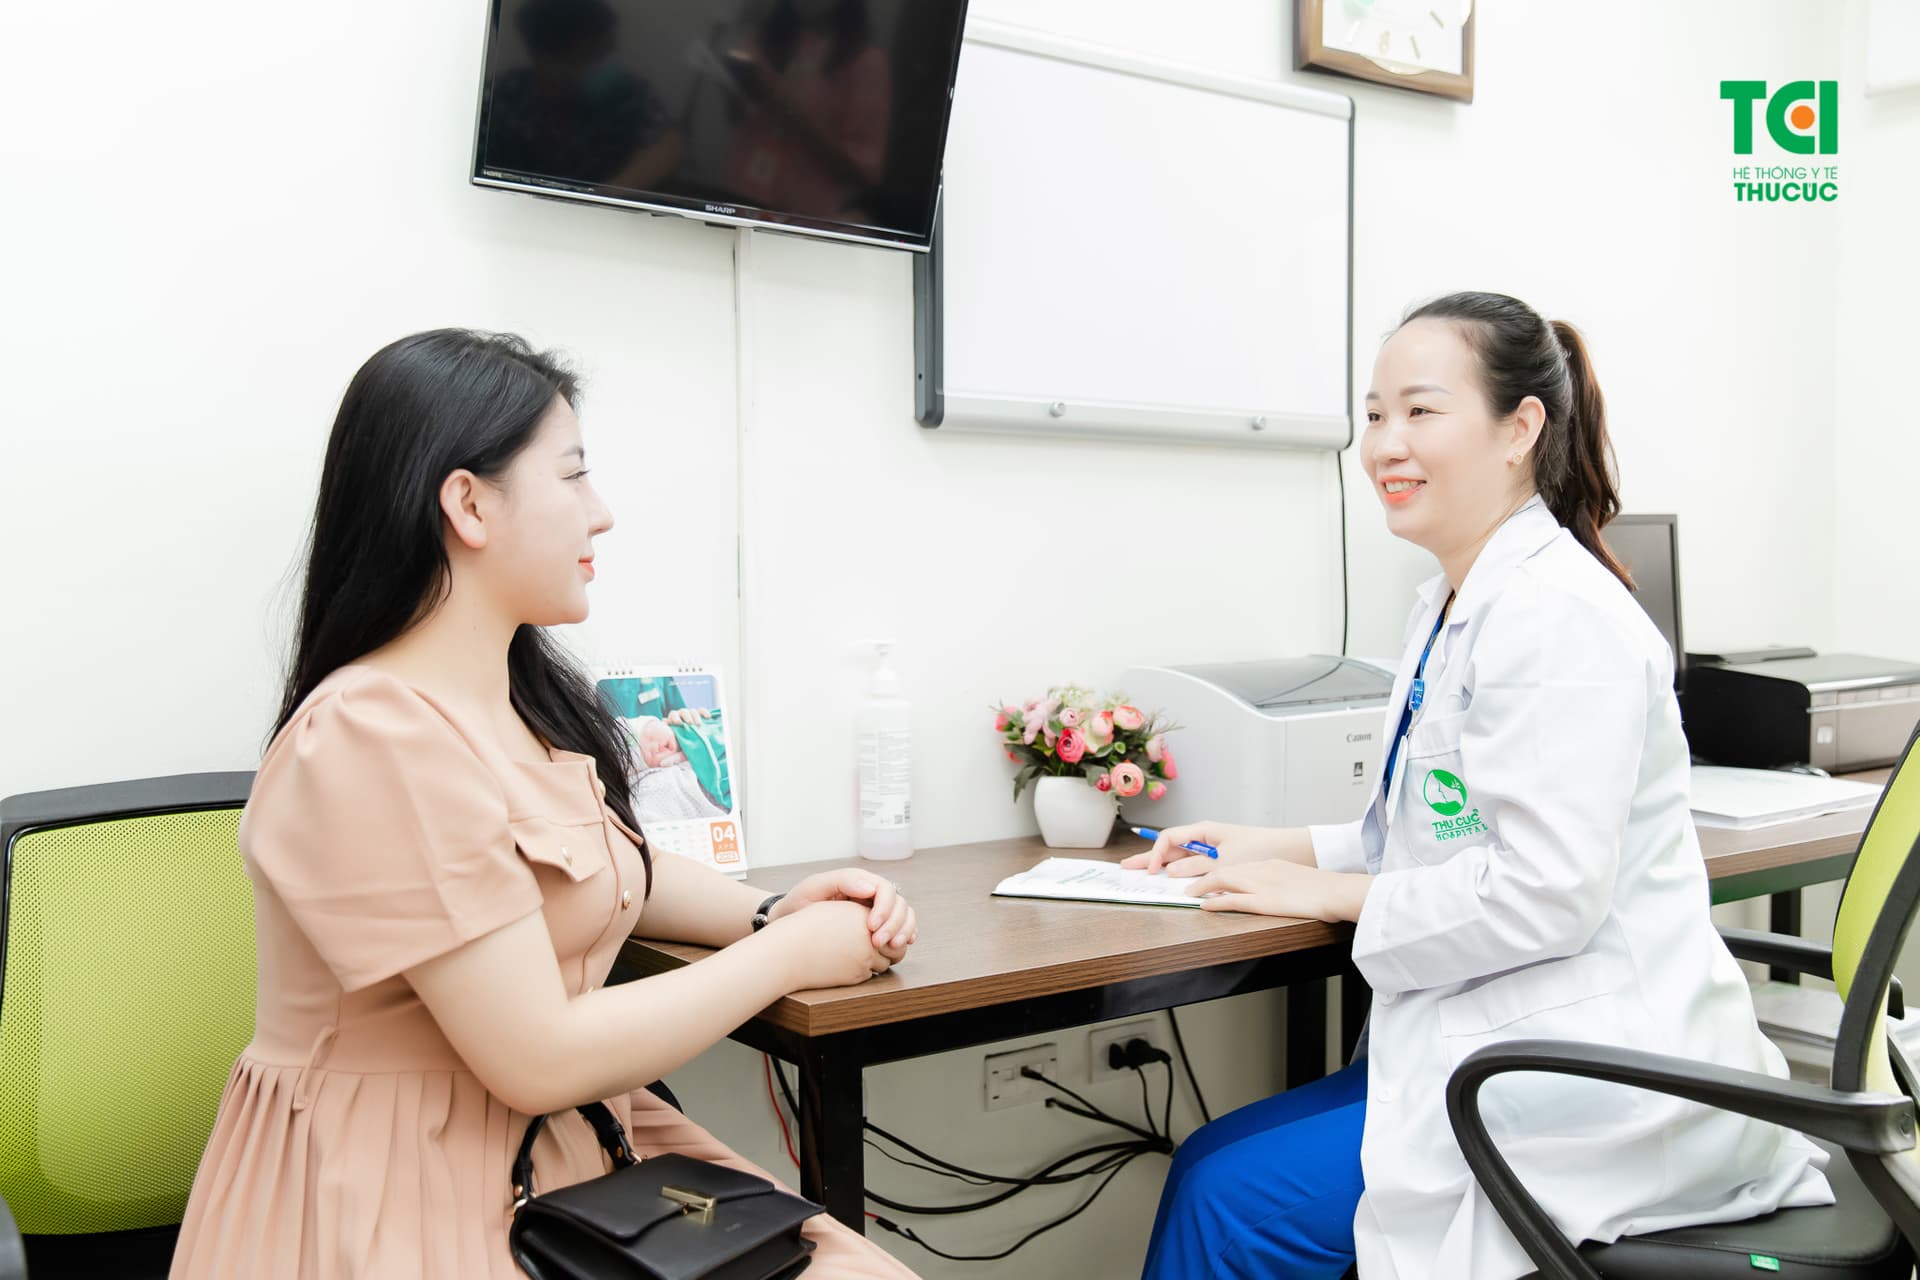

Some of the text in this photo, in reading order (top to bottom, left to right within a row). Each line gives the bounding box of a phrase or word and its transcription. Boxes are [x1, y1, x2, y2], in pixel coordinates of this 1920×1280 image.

[705, 204, 736, 214] SHARP
[1346, 733, 1372, 743] Canon
[1431, 820, 1454, 831] THU
[713, 825, 735, 842] 04
[1435, 823, 1488, 841] HOSPITAL
